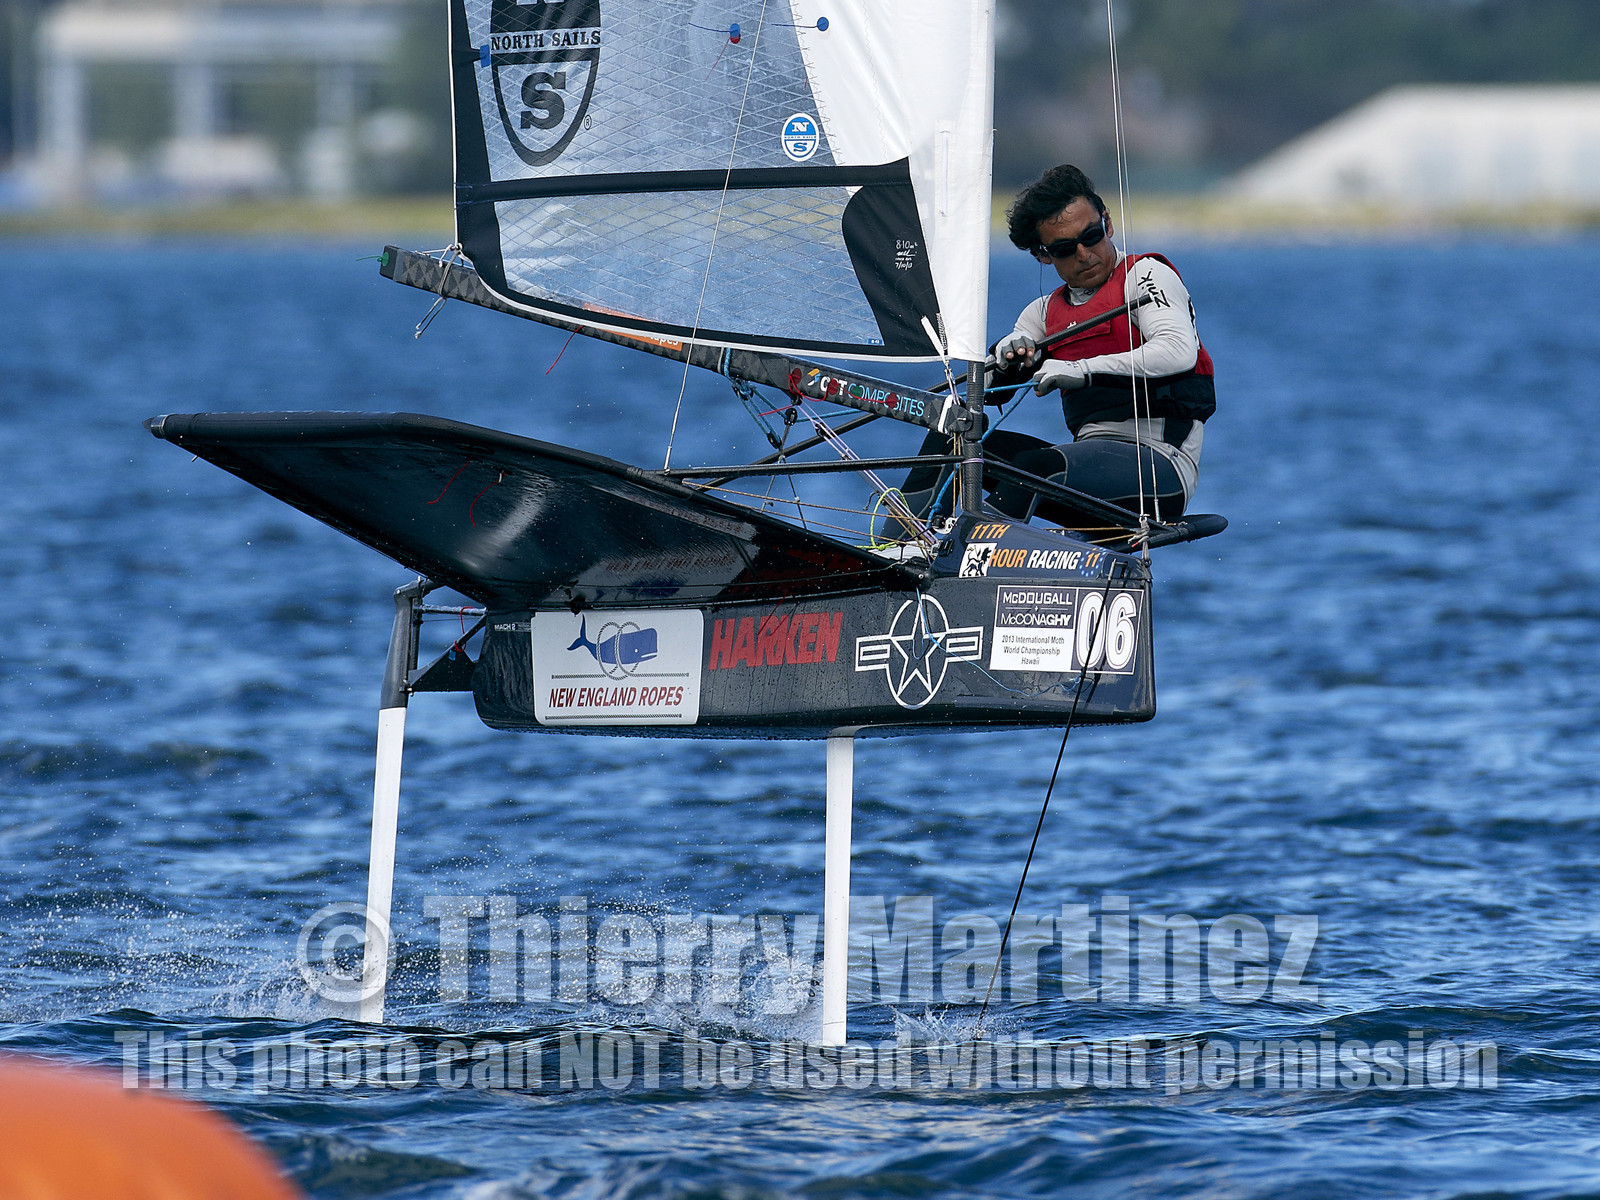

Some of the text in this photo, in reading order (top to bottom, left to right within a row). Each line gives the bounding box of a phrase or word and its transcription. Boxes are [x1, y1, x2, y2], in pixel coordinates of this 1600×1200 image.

[490, 29, 601, 51] NORTH SAILS
[520, 71, 567, 129] S
[791, 121, 810, 132] N
[793, 142, 808, 152] S
[820, 375, 848, 396] CT
[970, 523, 1011, 540] 11TH
[988, 548, 1082, 570] HOUR RACING
[1002, 591, 1073, 605] McDOUGALL
[494, 623, 511, 631] MACH
[1000, 612, 1072, 626] McCONAGHY
[1001, 634, 1015, 643] 2013
[1015, 635, 1050, 644] International
[1076, 591, 1137, 670] 06
[708, 611, 844, 671] HARKEN
[1003, 646, 1061, 656] World Championship
[549, 686, 684, 708] NEW ENGLAND ROPES
